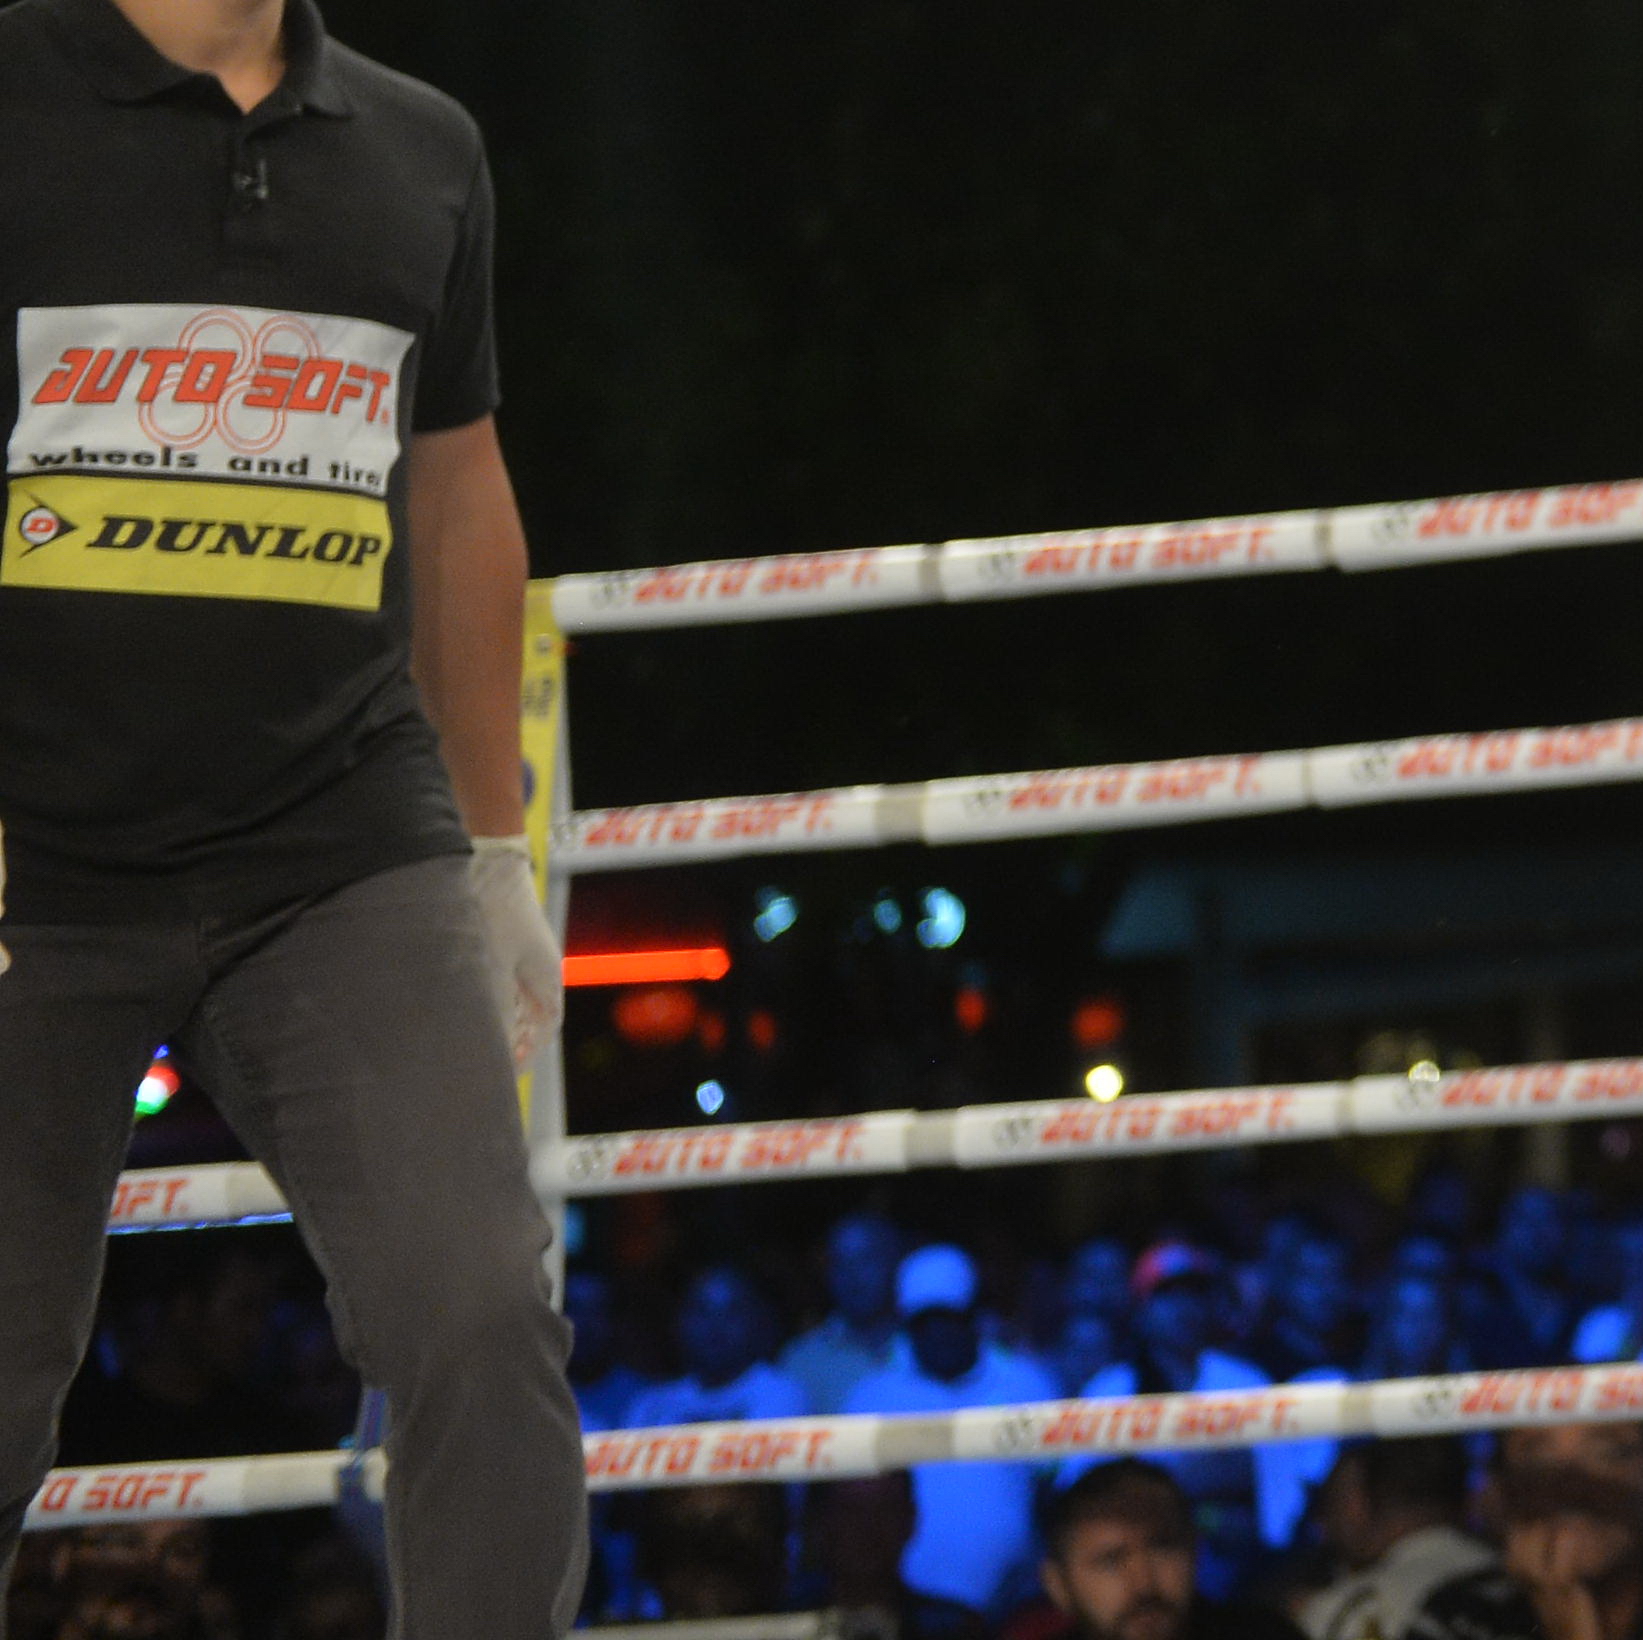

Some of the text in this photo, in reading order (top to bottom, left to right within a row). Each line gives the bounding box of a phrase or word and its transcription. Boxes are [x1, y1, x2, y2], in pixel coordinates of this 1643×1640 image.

[32, 347, 237, 405] AUTO
[30, 446, 199, 469] wheels
[228, 454, 309, 478] and
[87, 515, 381, 566] DUNLOP
